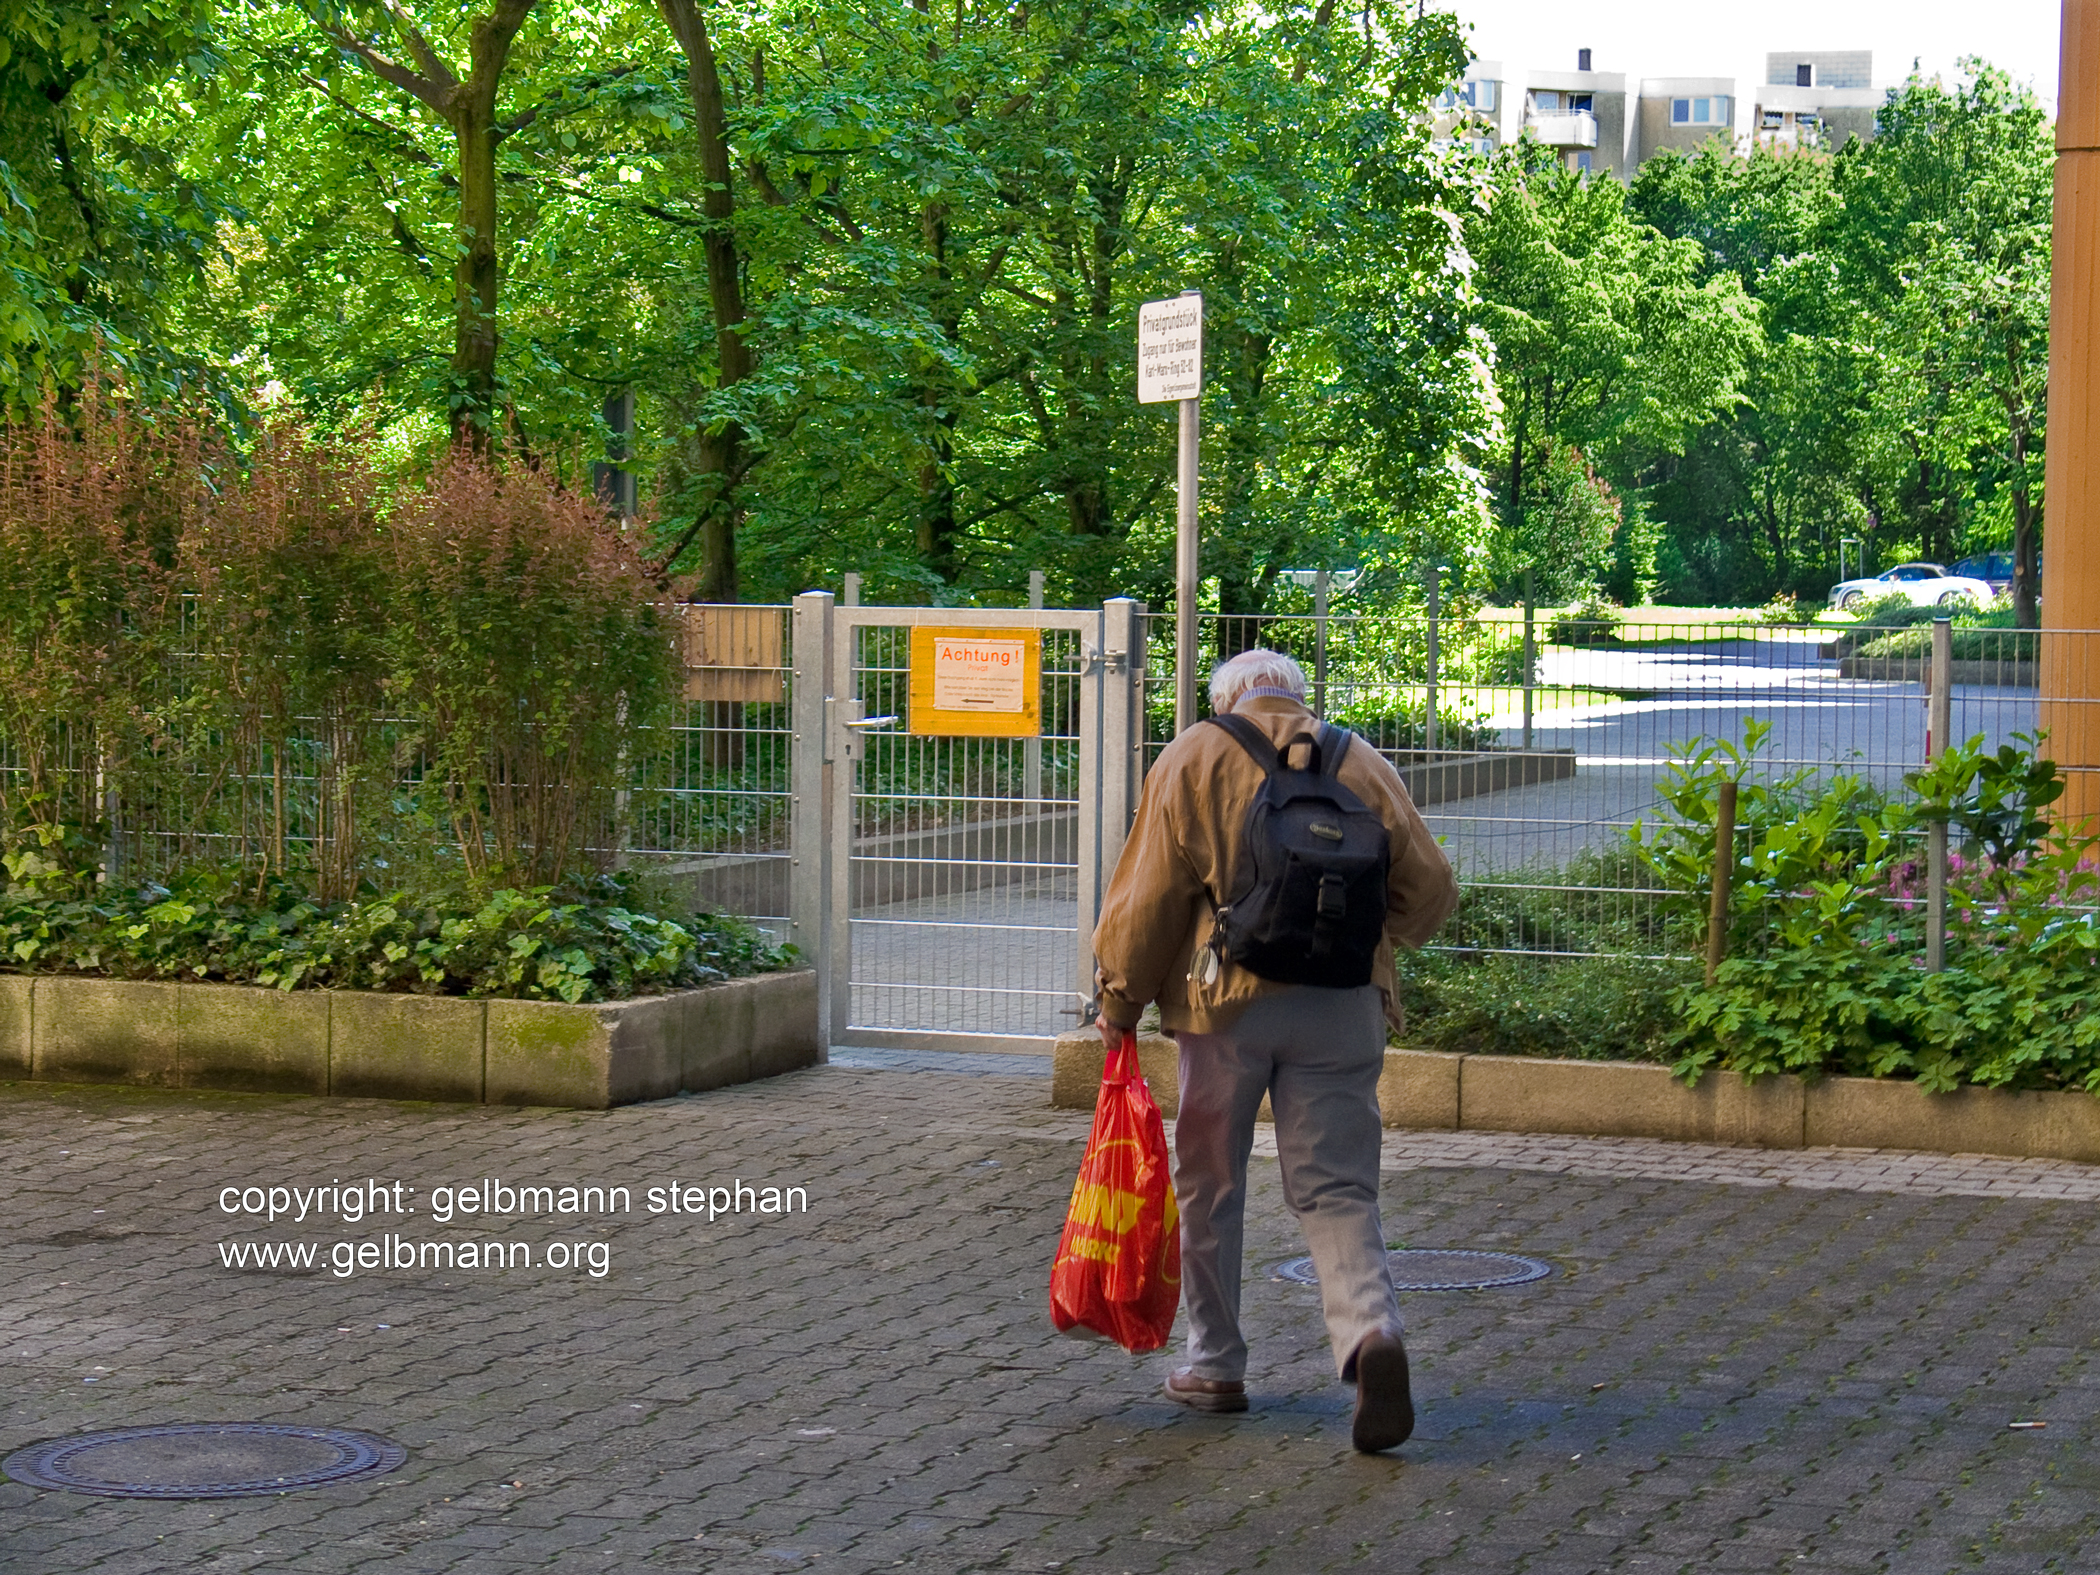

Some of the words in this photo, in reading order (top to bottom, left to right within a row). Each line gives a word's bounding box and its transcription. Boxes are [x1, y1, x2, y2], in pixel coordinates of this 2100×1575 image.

[1143, 307, 1198, 336] Privatgrundstück
[1143, 343, 1158, 359] Zugang
[1176, 338, 1197, 352] Bewohner
[1145, 361, 1179, 378] Karl-Marx-Ring
[967, 664, 989, 672] Privat
[1069, 1234, 1121, 1265] MARKT
